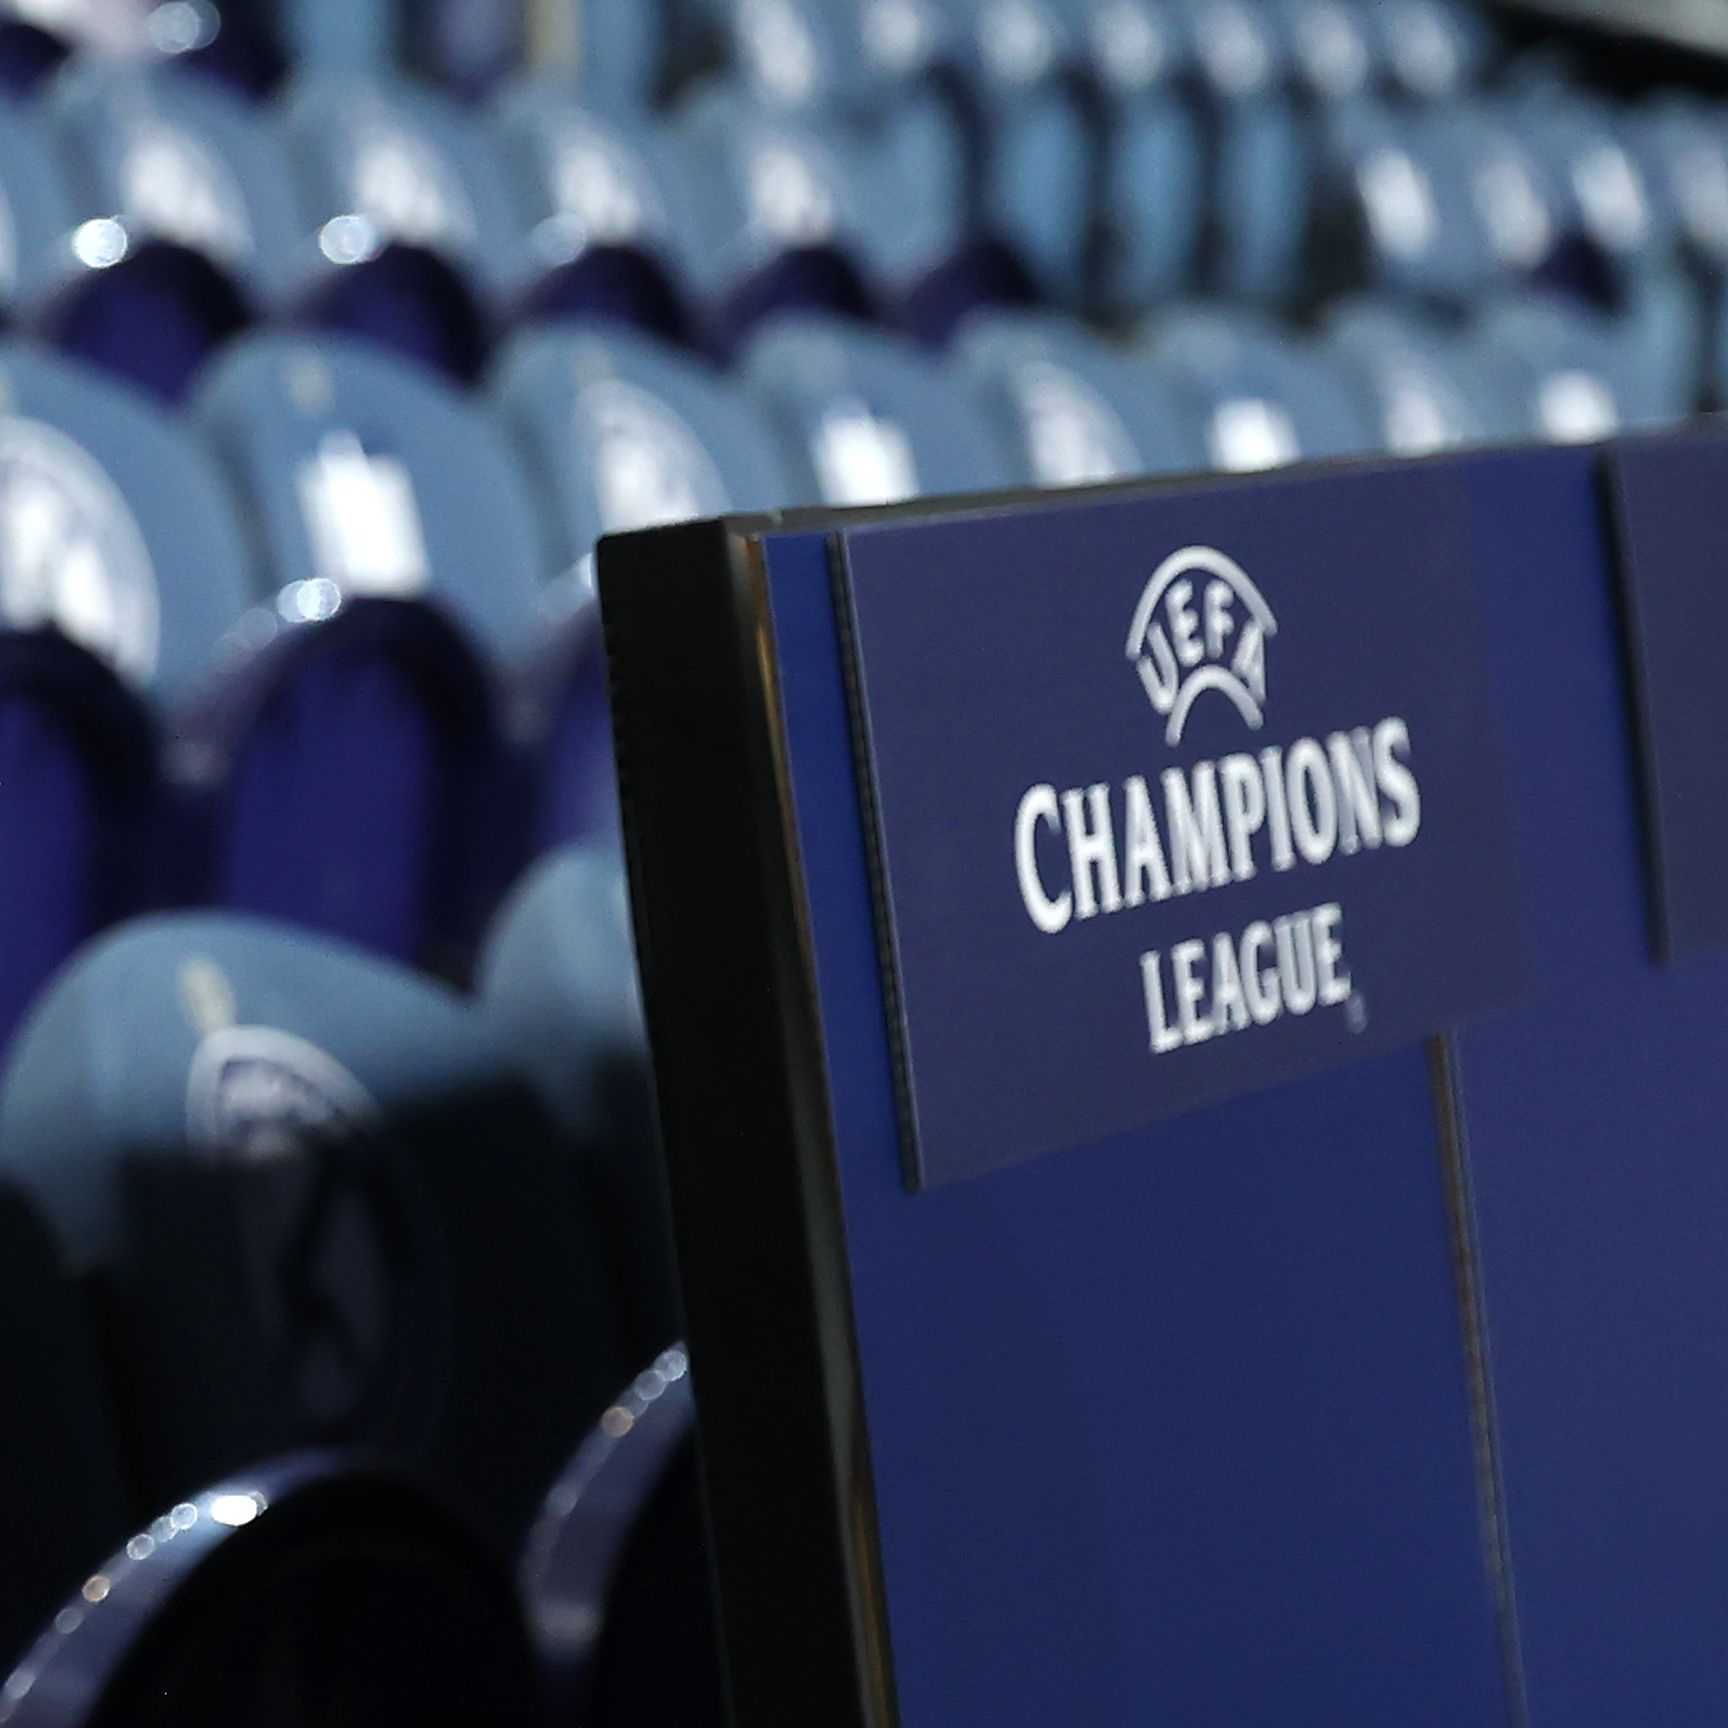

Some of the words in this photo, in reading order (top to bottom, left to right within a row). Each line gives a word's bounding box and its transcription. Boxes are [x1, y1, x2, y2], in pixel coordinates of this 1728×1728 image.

[1137, 578, 1267, 715] UEFA
[1014, 716, 1422, 934] CHAMPIONS
[1140, 902, 1352, 1054] LEAGUE
